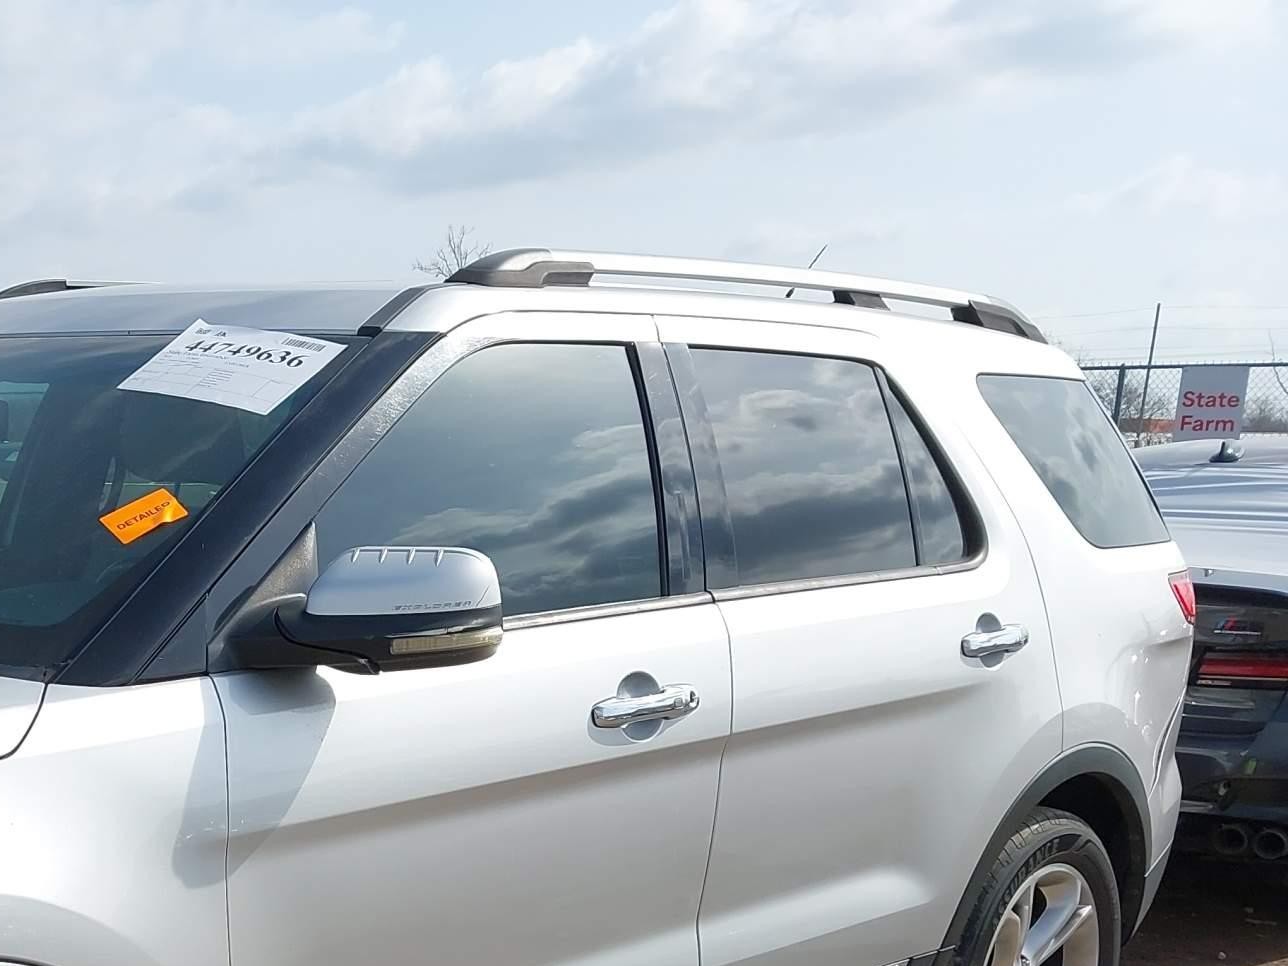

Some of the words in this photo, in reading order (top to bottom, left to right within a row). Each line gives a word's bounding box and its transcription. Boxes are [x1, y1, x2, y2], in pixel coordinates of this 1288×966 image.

[185, 339, 310, 368] 44749636
[1182, 391, 1240, 408] State
[1180, 415, 1235, 432] Farm
